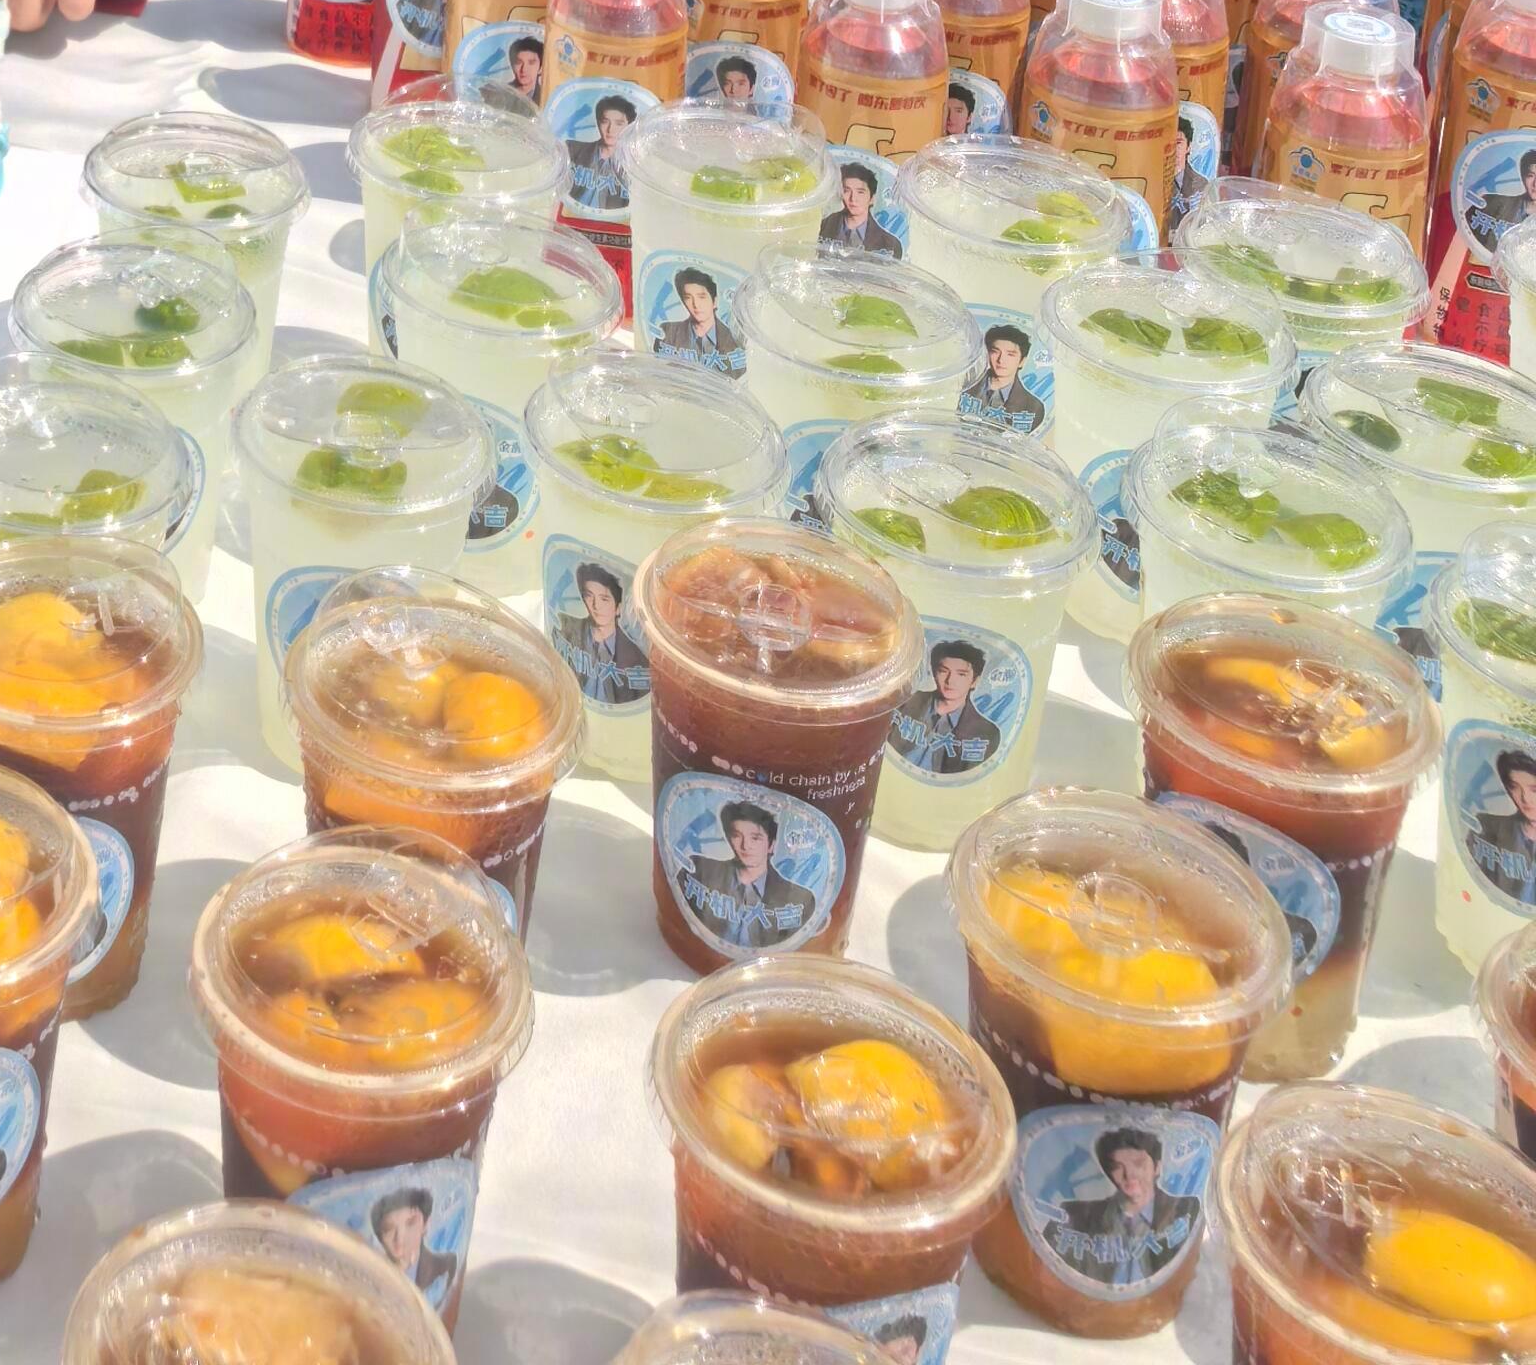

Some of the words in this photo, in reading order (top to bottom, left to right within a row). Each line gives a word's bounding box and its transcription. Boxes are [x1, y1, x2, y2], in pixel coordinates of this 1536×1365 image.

[789, 774, 831, 787] chain
[835, 770, 850, 784] by
[683, 874, 805, 930] 开机大吉
